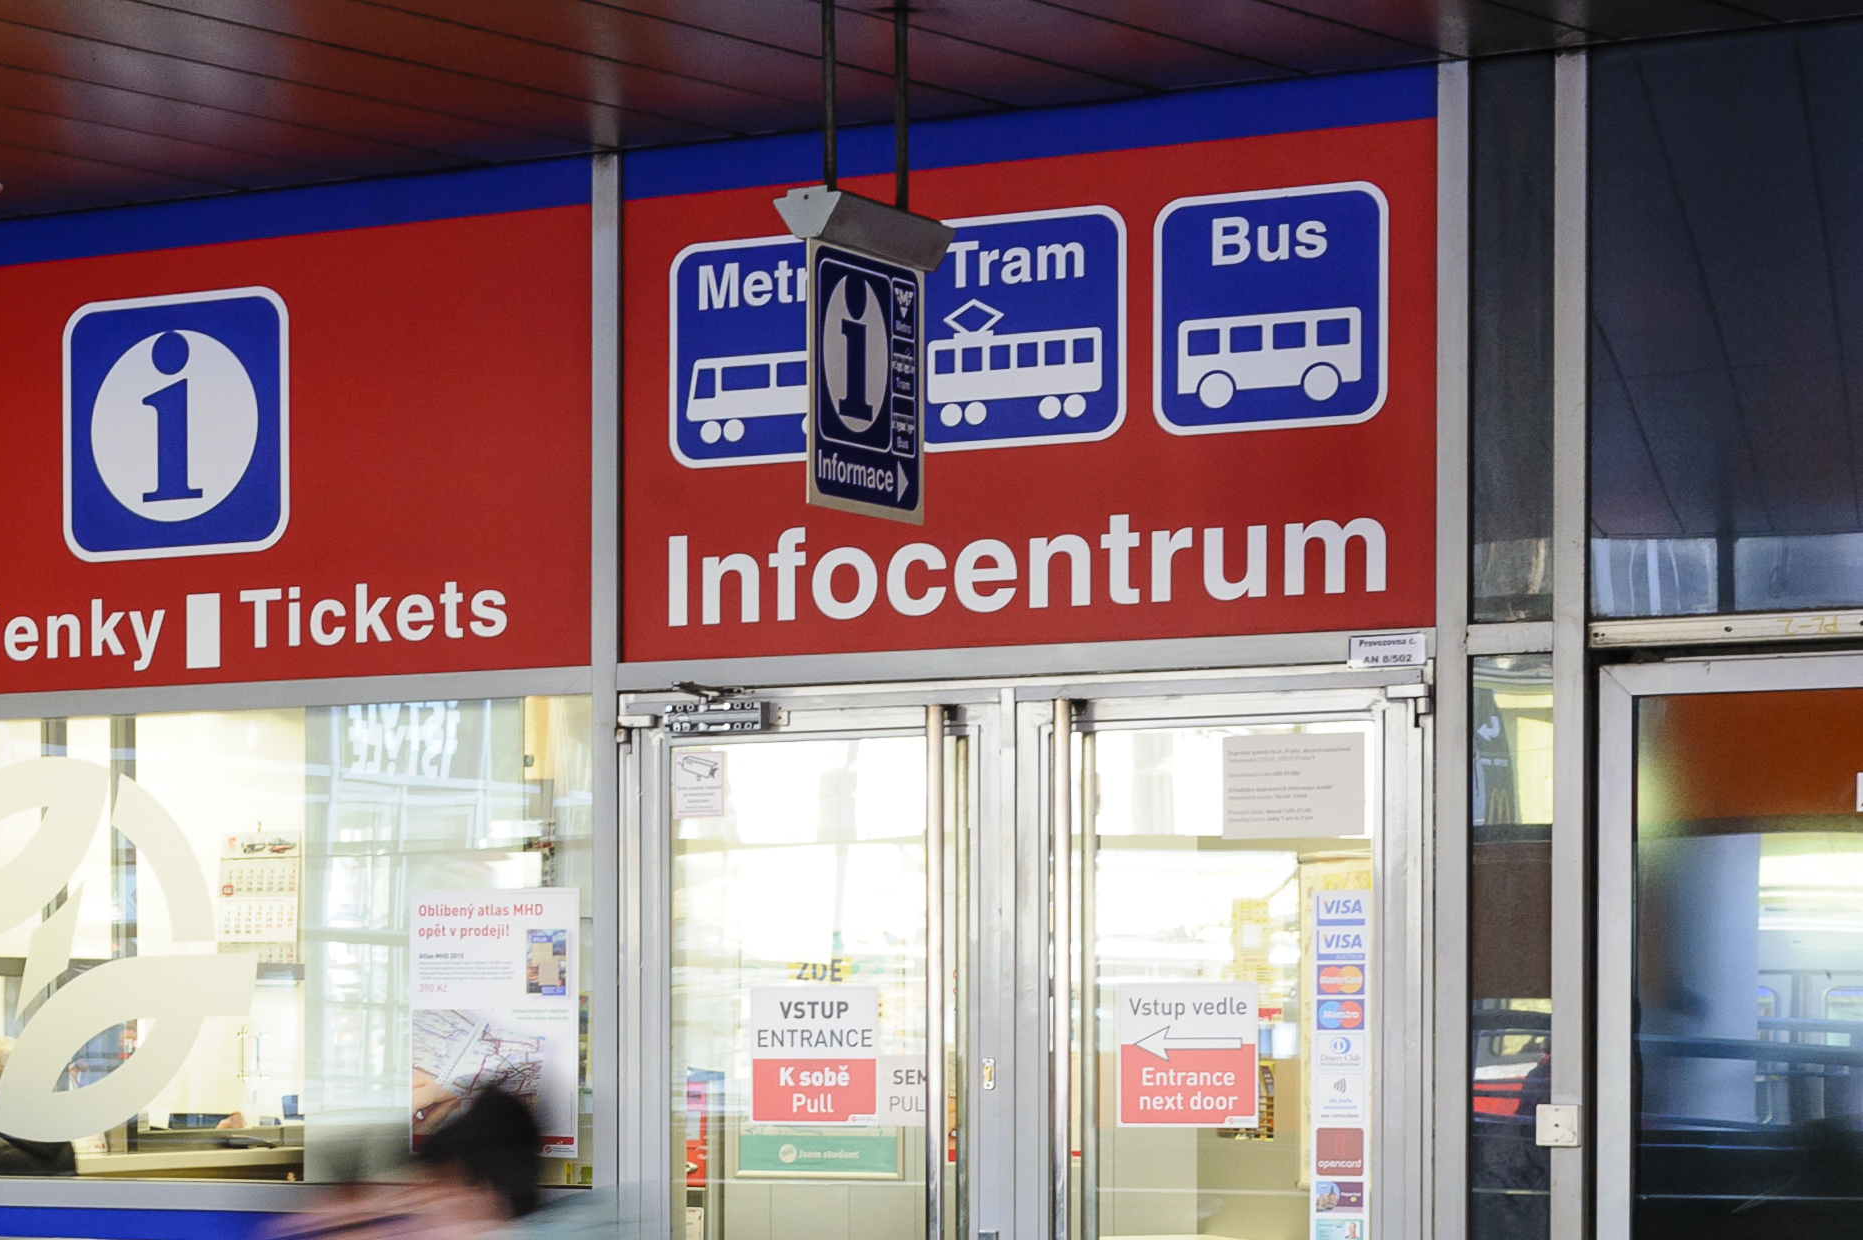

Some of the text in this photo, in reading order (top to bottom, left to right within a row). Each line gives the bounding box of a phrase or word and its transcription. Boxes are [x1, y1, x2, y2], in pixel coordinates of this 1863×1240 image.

[1210, 216, 1328, 267] Bus
[697, 238, 1085, 311] Metr Tram
[896, 377, 911, 391] Tram
[897, 435, 909, 450] Bus
[818, 449, 894, 492] Informace
[668, 513, 1387, 628] Infocentrum
[239, 581, 509, 649] Tickets
[1363, 653, 1413, 664] AN 8/502
[418, 903, 544, 919] Oblíbený atlas MHD
[1323, 900, 1363, 914] VISA
[418, 924, 510, 940] opět v prodeji!
[1323, 934, 1363, 948] VISA
[779, 1001, 849, 1019] VSTUP
[1129, 997, 1248, 1020] Vstup vedle
[757, 1029, 873, 1048] ENTRANCE
[1343, 1053, 1362, 1062] Club
[779, 1065, 850, 1087] K sobě
[1141, 1067, 1236, 1087] Entrance
[792, 1093, 834, 1114] Pull
[889, 1096, 926, 1112] PUL
[1139, 1091, 1239, 1111] next door
[823, 1148, 860, 1160] student
[1317, 1158, 1362, 1169] opencard
